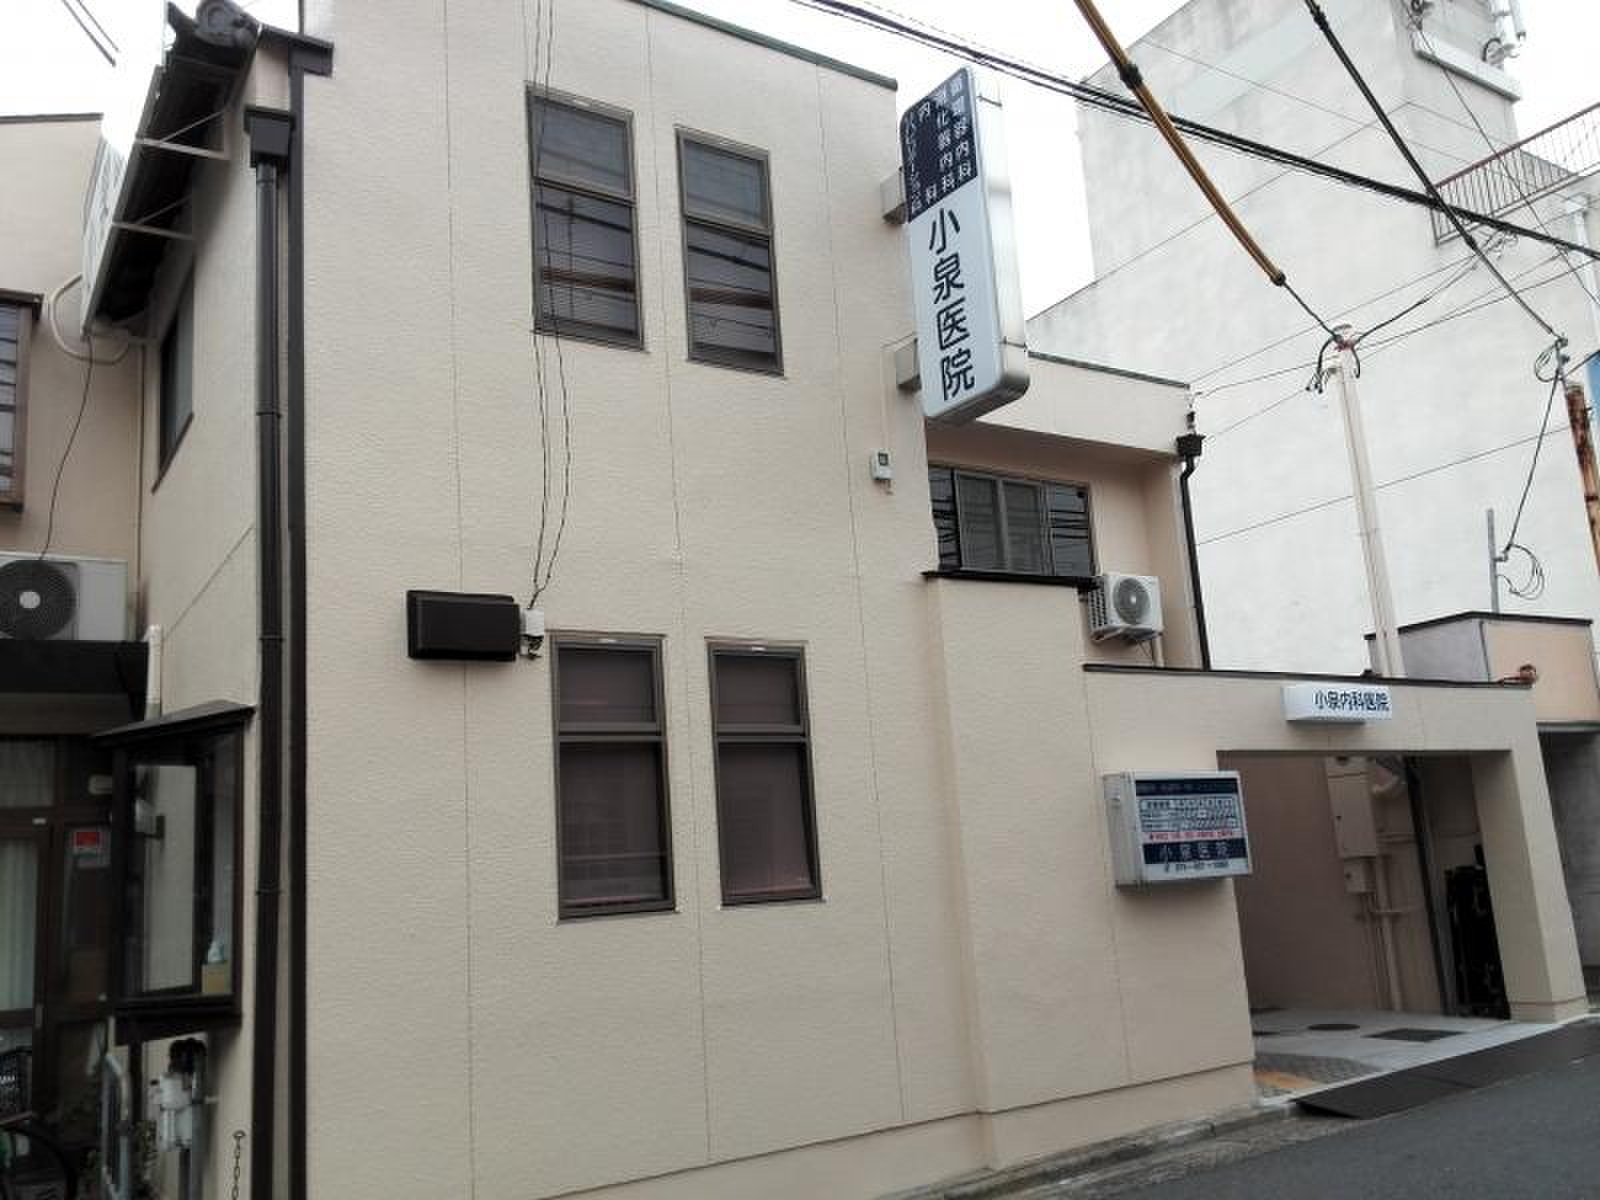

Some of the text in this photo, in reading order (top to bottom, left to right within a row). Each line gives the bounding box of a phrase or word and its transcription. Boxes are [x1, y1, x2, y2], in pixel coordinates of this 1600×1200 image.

[928, 207, 975, 401] 小泉医院
[1314, 690, 1390, 711] 小泉内科医院
